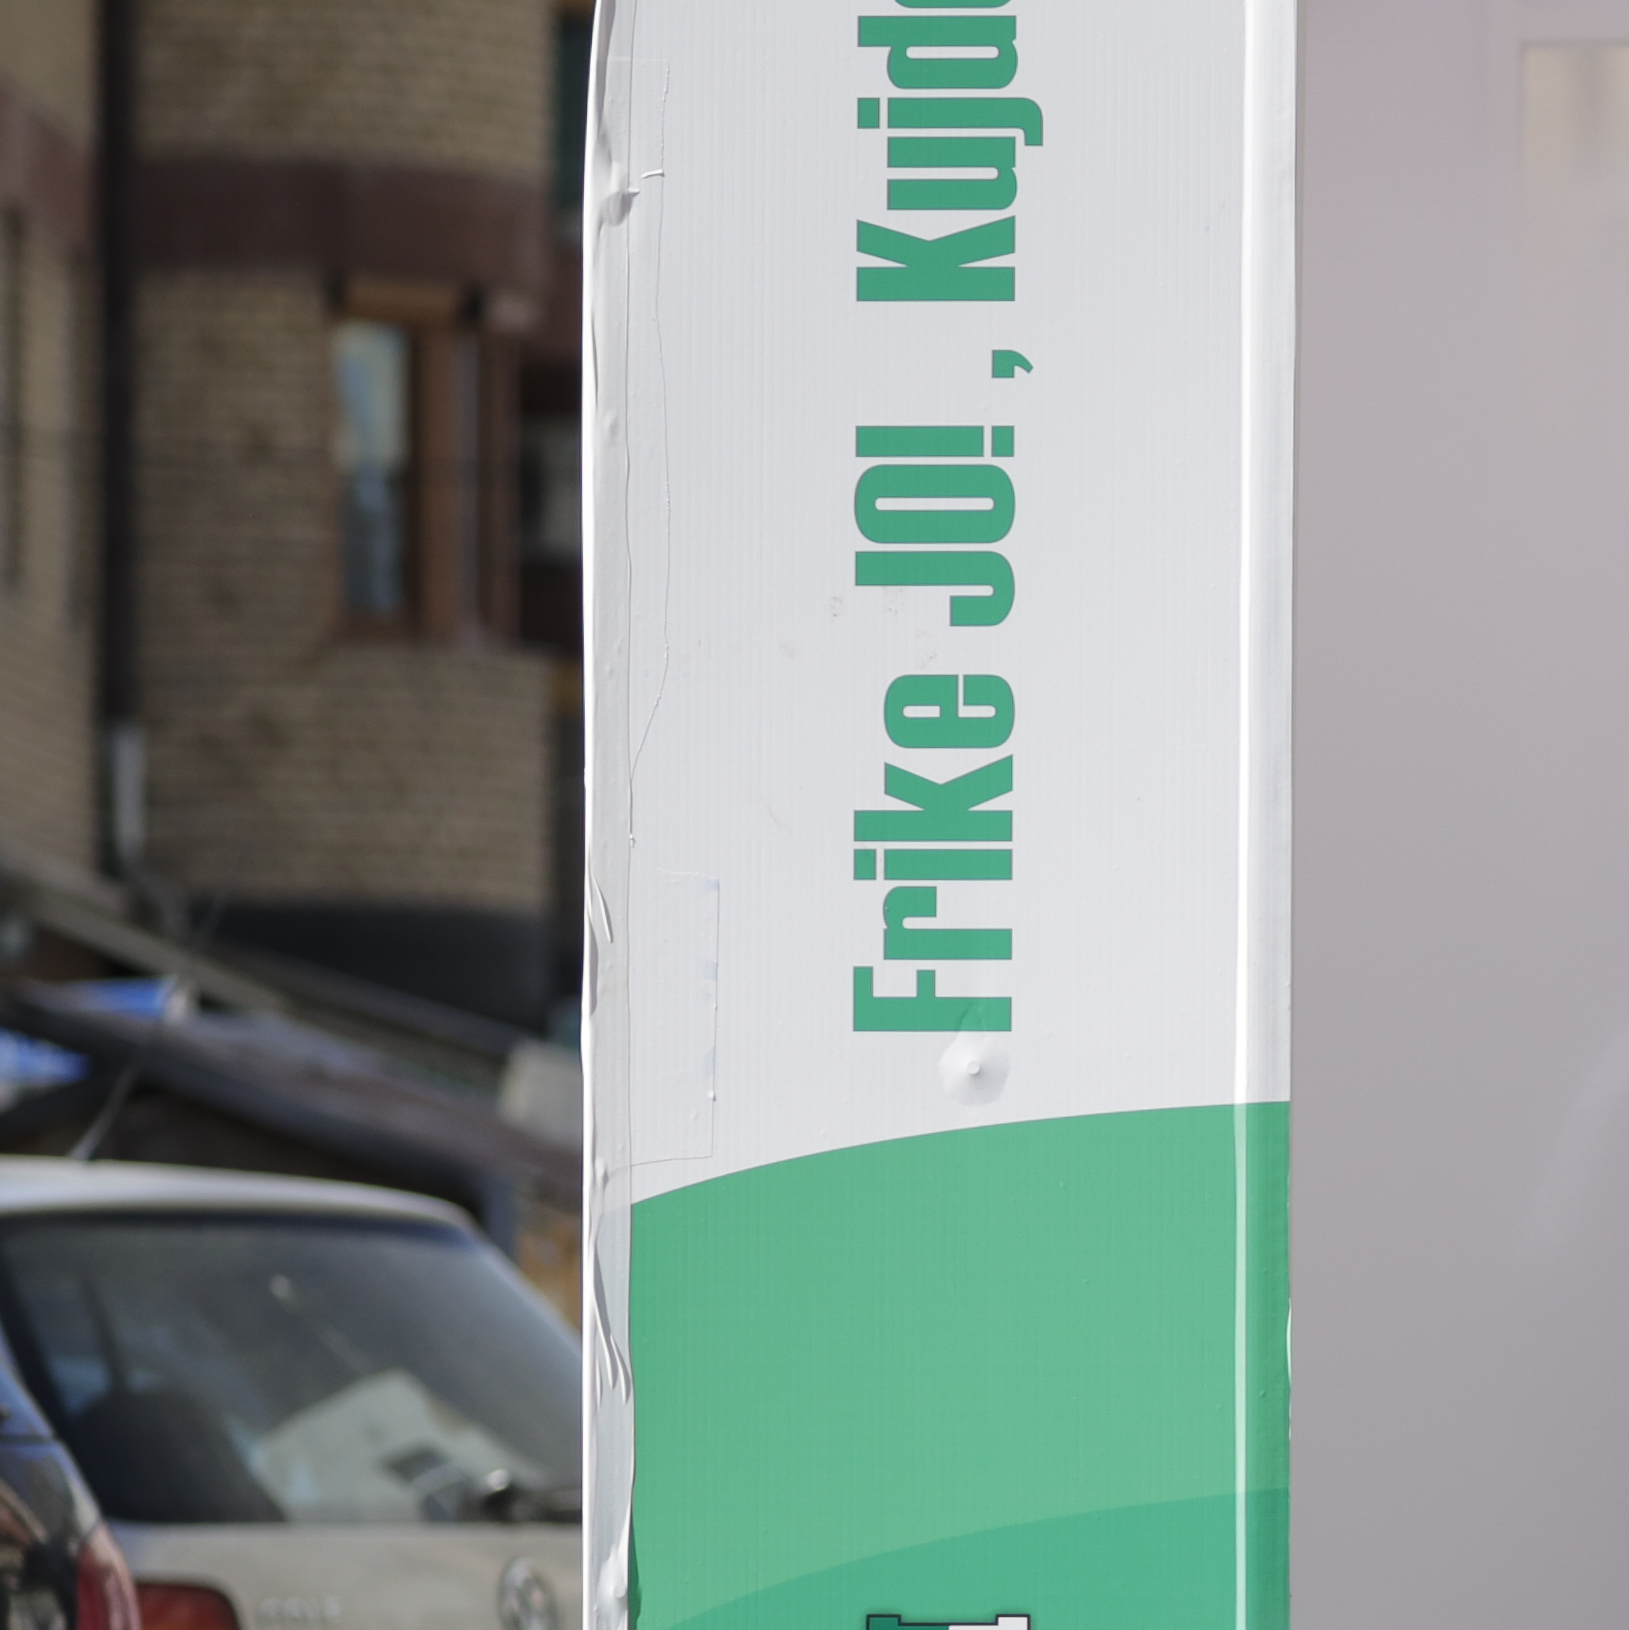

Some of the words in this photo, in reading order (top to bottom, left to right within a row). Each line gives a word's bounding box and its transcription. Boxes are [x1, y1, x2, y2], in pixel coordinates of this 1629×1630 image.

[857, 0, 1043, 302] Kujd
[854, 425, 1016, 627] JO!
[853, 674, 1015, 1032] Frike
